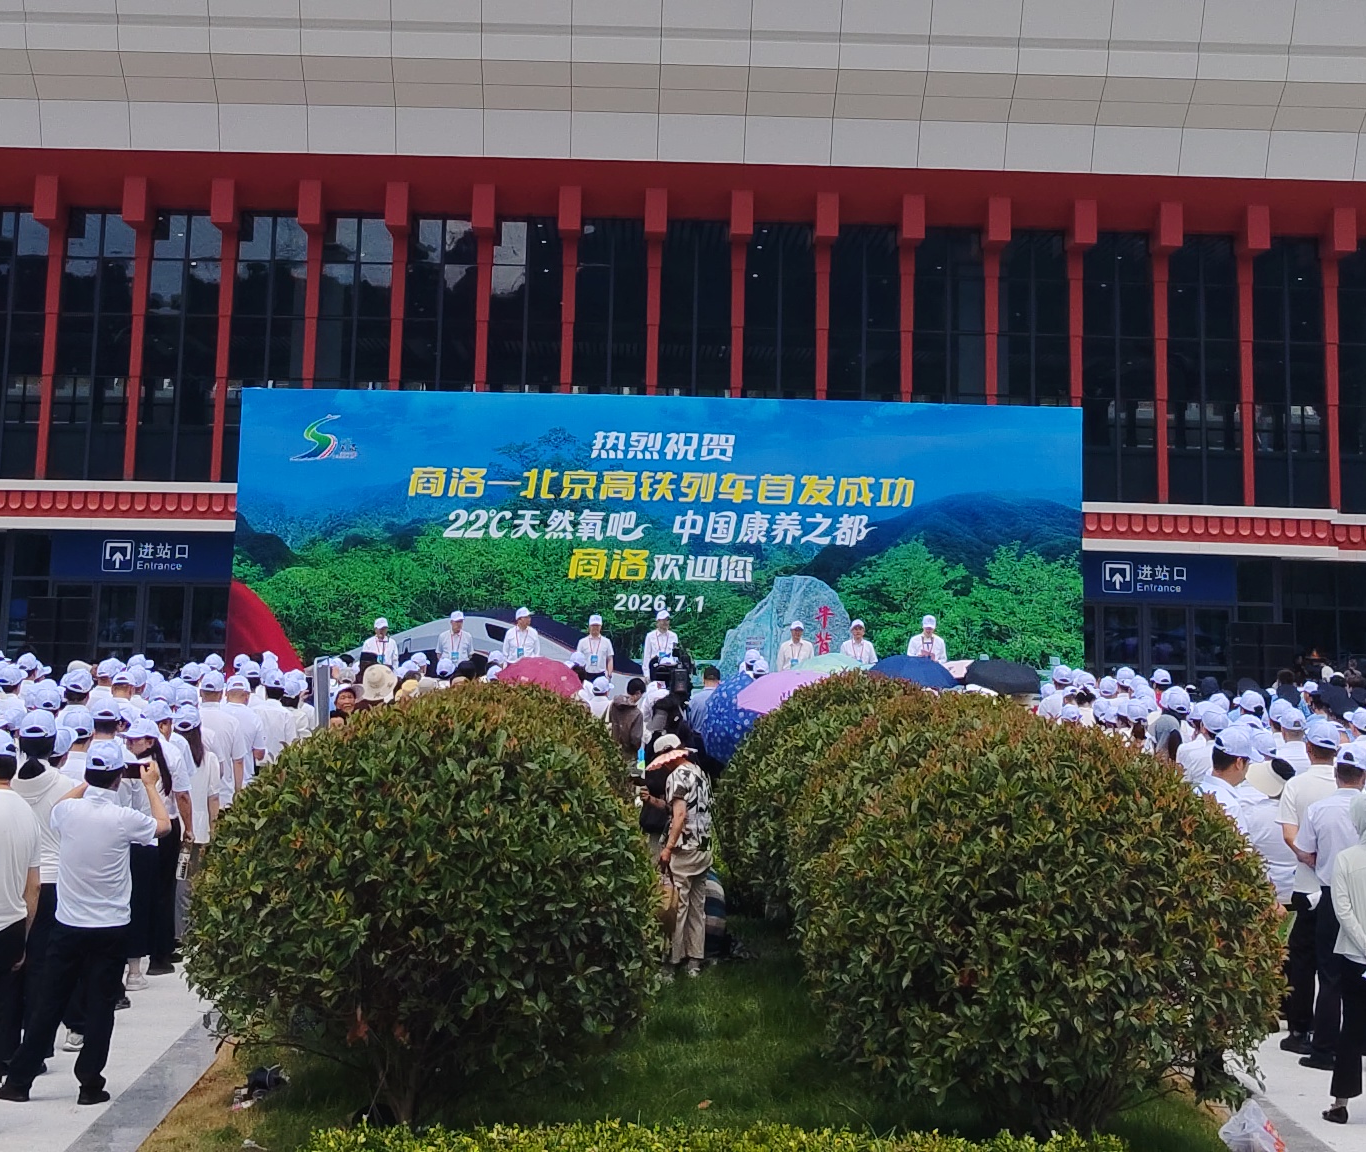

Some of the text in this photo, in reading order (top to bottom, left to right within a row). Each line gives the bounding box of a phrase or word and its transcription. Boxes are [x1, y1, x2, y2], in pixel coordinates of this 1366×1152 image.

[591, 431, 735, 461] 热烈祝贺
[673, 510, 878, 547] 中国康养之都
[138, 543, 189, 559] 进站口
[137, 561, 182, 571] Entrance
[568, 548, 754, 582] 商洛欢迎您
[1137, 565, 1187, 581] 进站口
[1137, 583, 1181, 593] Entrance
[614, 594, 704, 613] 2026.7.1
